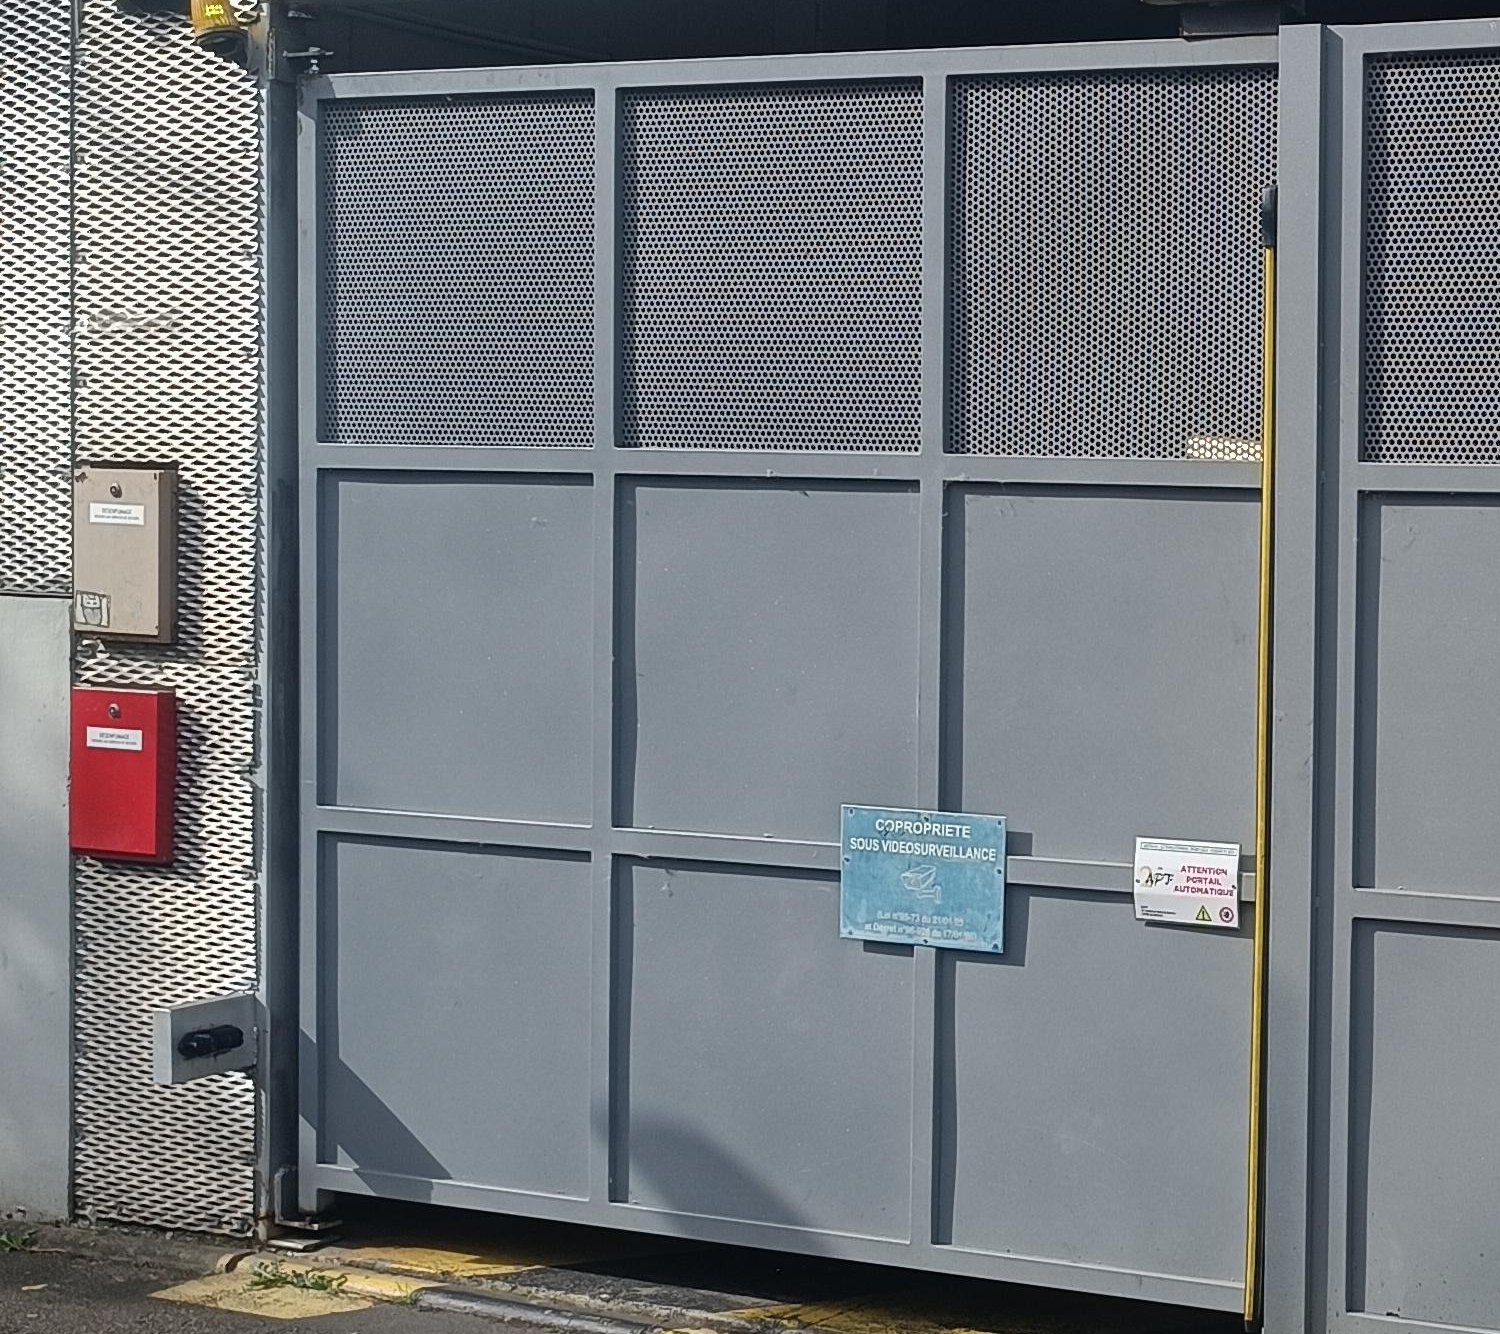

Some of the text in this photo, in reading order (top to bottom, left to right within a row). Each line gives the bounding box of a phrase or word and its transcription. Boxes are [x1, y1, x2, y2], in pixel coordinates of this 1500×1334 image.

[875, 818, 971, 838] COPROPRIETE
[850, 837, 997, 861] SOUS VIDEOSURVEILLANCE
[1180, 865, 1228, 876] ATTENTION
[1186, 875, 1222, 886] PORTAIL
[1174, 885, 1234, 897] AUTOMATIQUE
